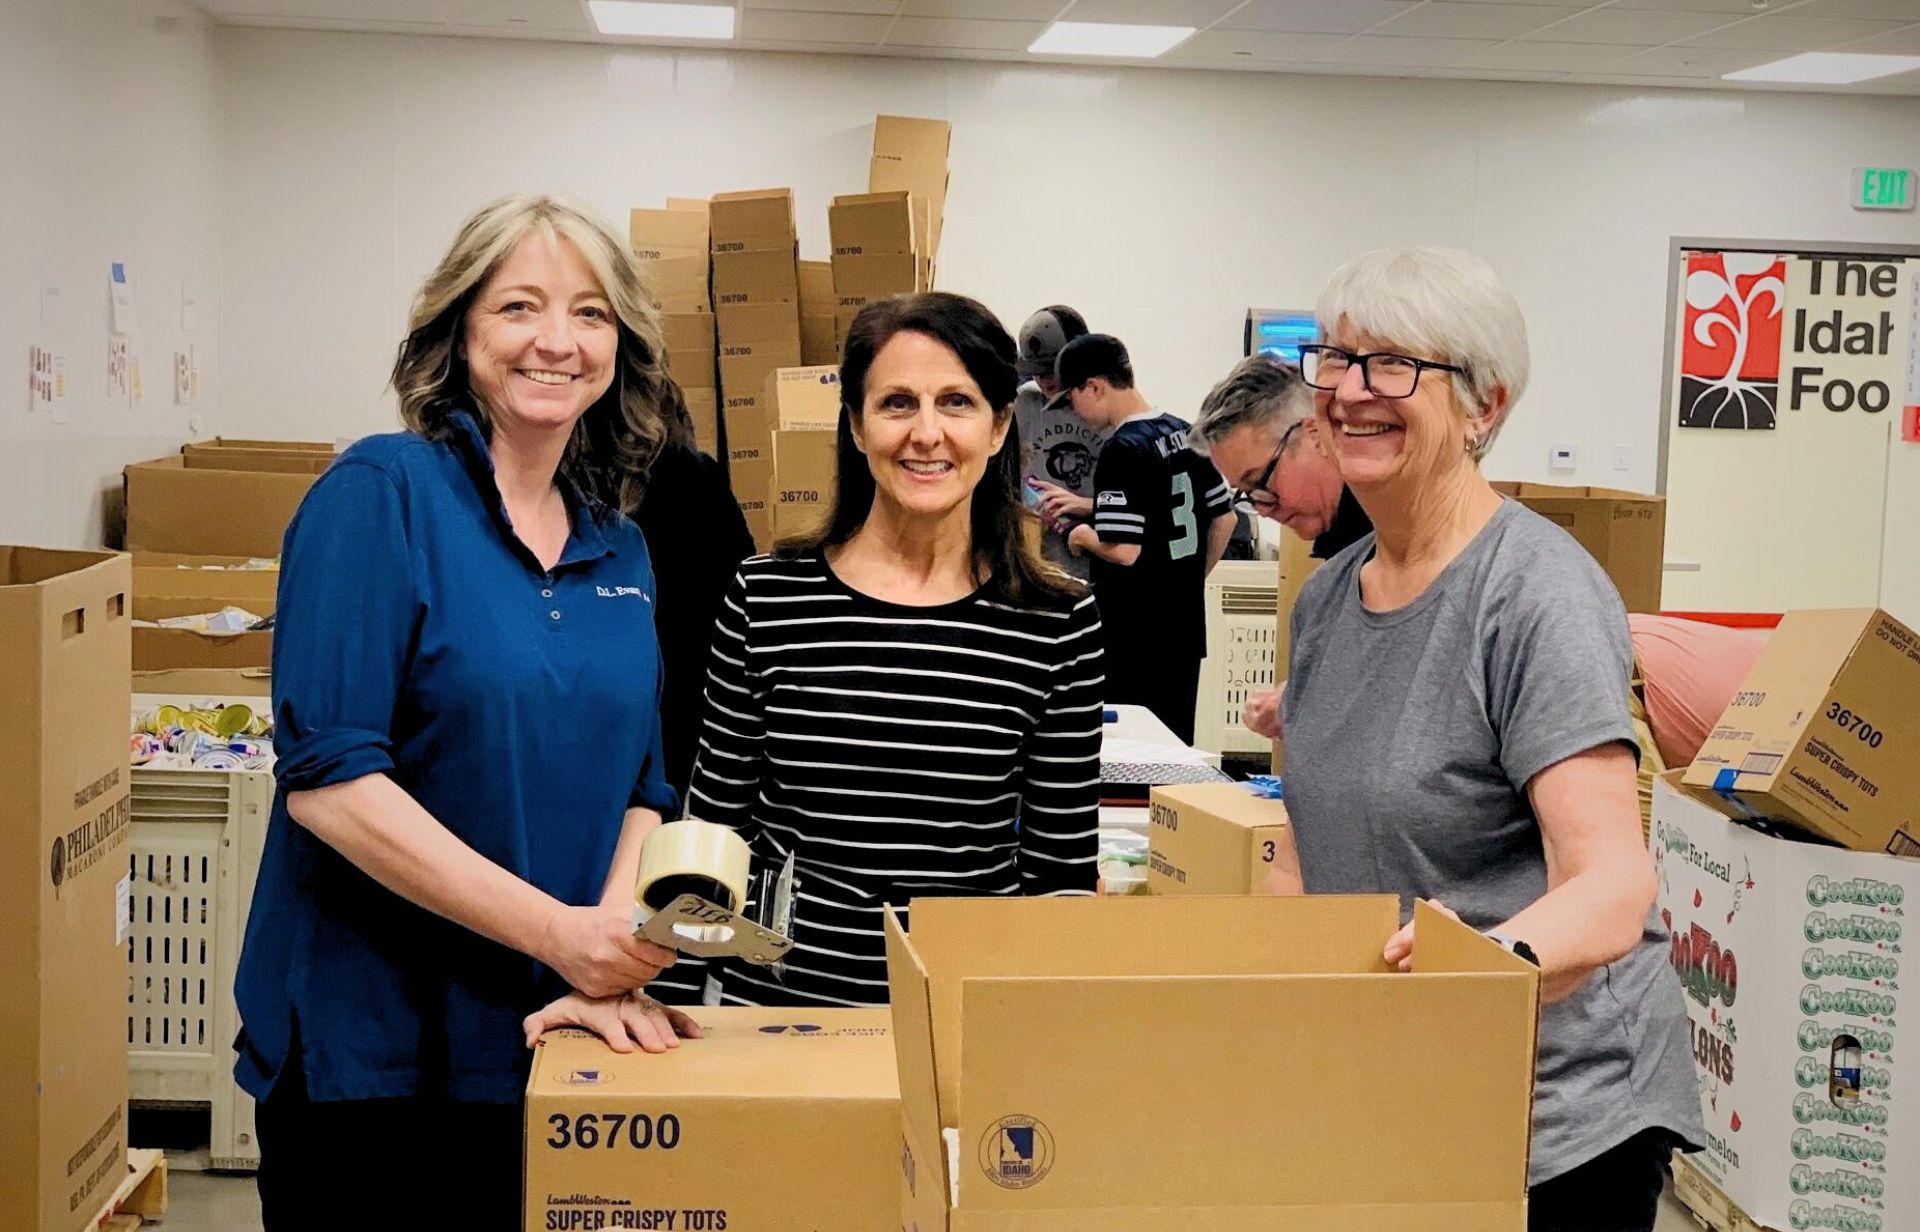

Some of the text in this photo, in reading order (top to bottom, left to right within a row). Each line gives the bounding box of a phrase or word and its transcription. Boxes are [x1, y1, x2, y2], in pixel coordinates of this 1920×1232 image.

[1863, 169, 1907, 204] EXIT
[1808, 259, 1898, 298] The
[724, 347, 751, 356] 36700
[727, 397, 755, 408] 36700
[1790, 366, 1891, 414] Foo
[731, 449, 759, 460] 36700
[738, 501, 764, 510] 6700
[780, 490, 818, 503] 36700
[1169, 472, 1198, 560] 3
[1876, 628, 1889, 640] DO
[1889, 637, 1908, 652] NOT
[1731, 691, 1766, 707] 36700
[1826, 702, 1883, 749] 36700
[1804, 742, 1831, 766] SUPER
[1830, 759, 1859, 783] CRISPY
[1858, 776, 1879, 797] TOTS
[1151, 802, 1178, 832] 36700
[1262, 840, 1275, 863] 3
[1689, 843, 1702, 867] For
[1703, 851, 1731, 883] Local
[1806, 874, 1904, 907] CooKoo
[1804, 911, 1901, 943] CooKoo
[1664, 918, 1738, 1008] ooKoo
[1801, 947, 1898, 980] CooKoo
[1799, 984, 1896, 1017] CooKoo
[1794, 1056, 1891, 1089] Cooo
[547, 1113, 680, 1149] 36700
[1791, 1127, 1886, 1162] CooKoo
[1002, 1165, 1031, 1175] IDAHO
[1789, 1163, 1884, 1198] CooKoo
[546, 1210, 727, 1232] SUPER CRISPY TOTS
[1788, 1199, 1882, 1232] CooKoo
